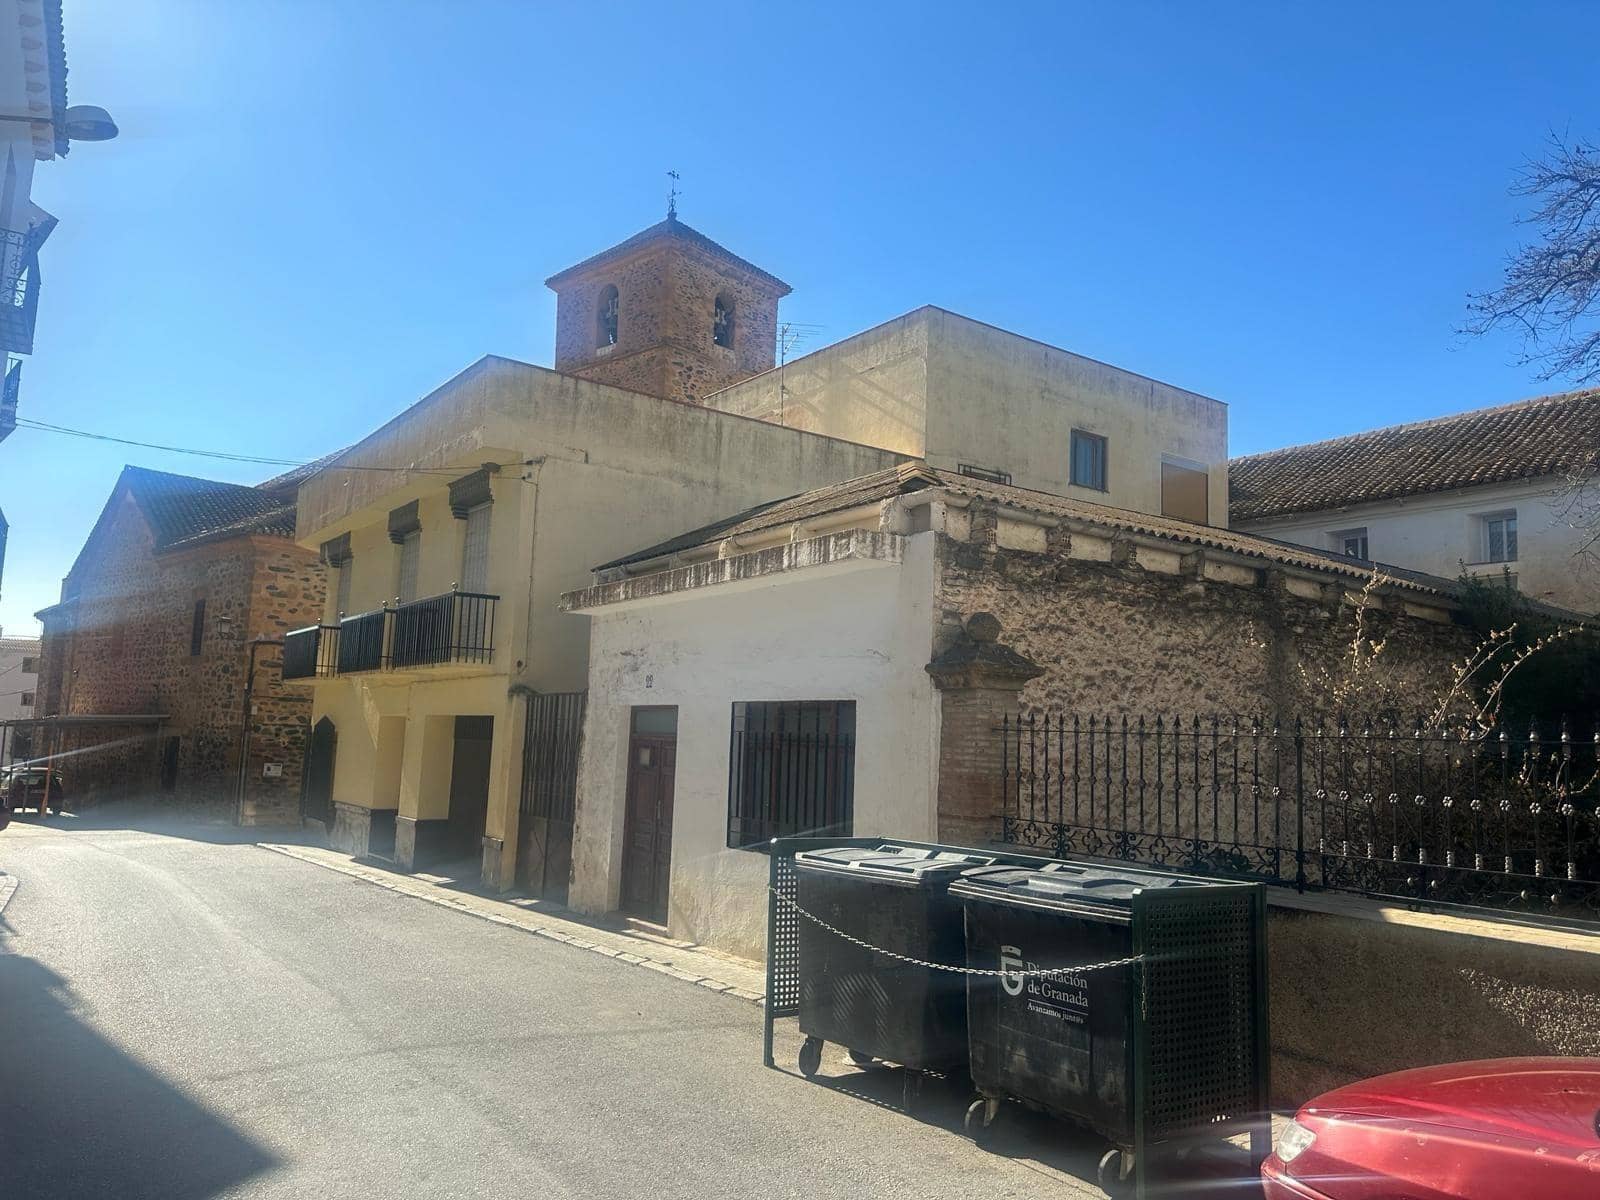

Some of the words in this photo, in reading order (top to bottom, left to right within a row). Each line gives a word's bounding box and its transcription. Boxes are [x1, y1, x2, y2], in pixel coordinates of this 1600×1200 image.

[1027, 979, 1040, 995] de
[1041, 983, 1089, 1007] Granada
[1027, 1002, 1061, 1018] Avanzamos
